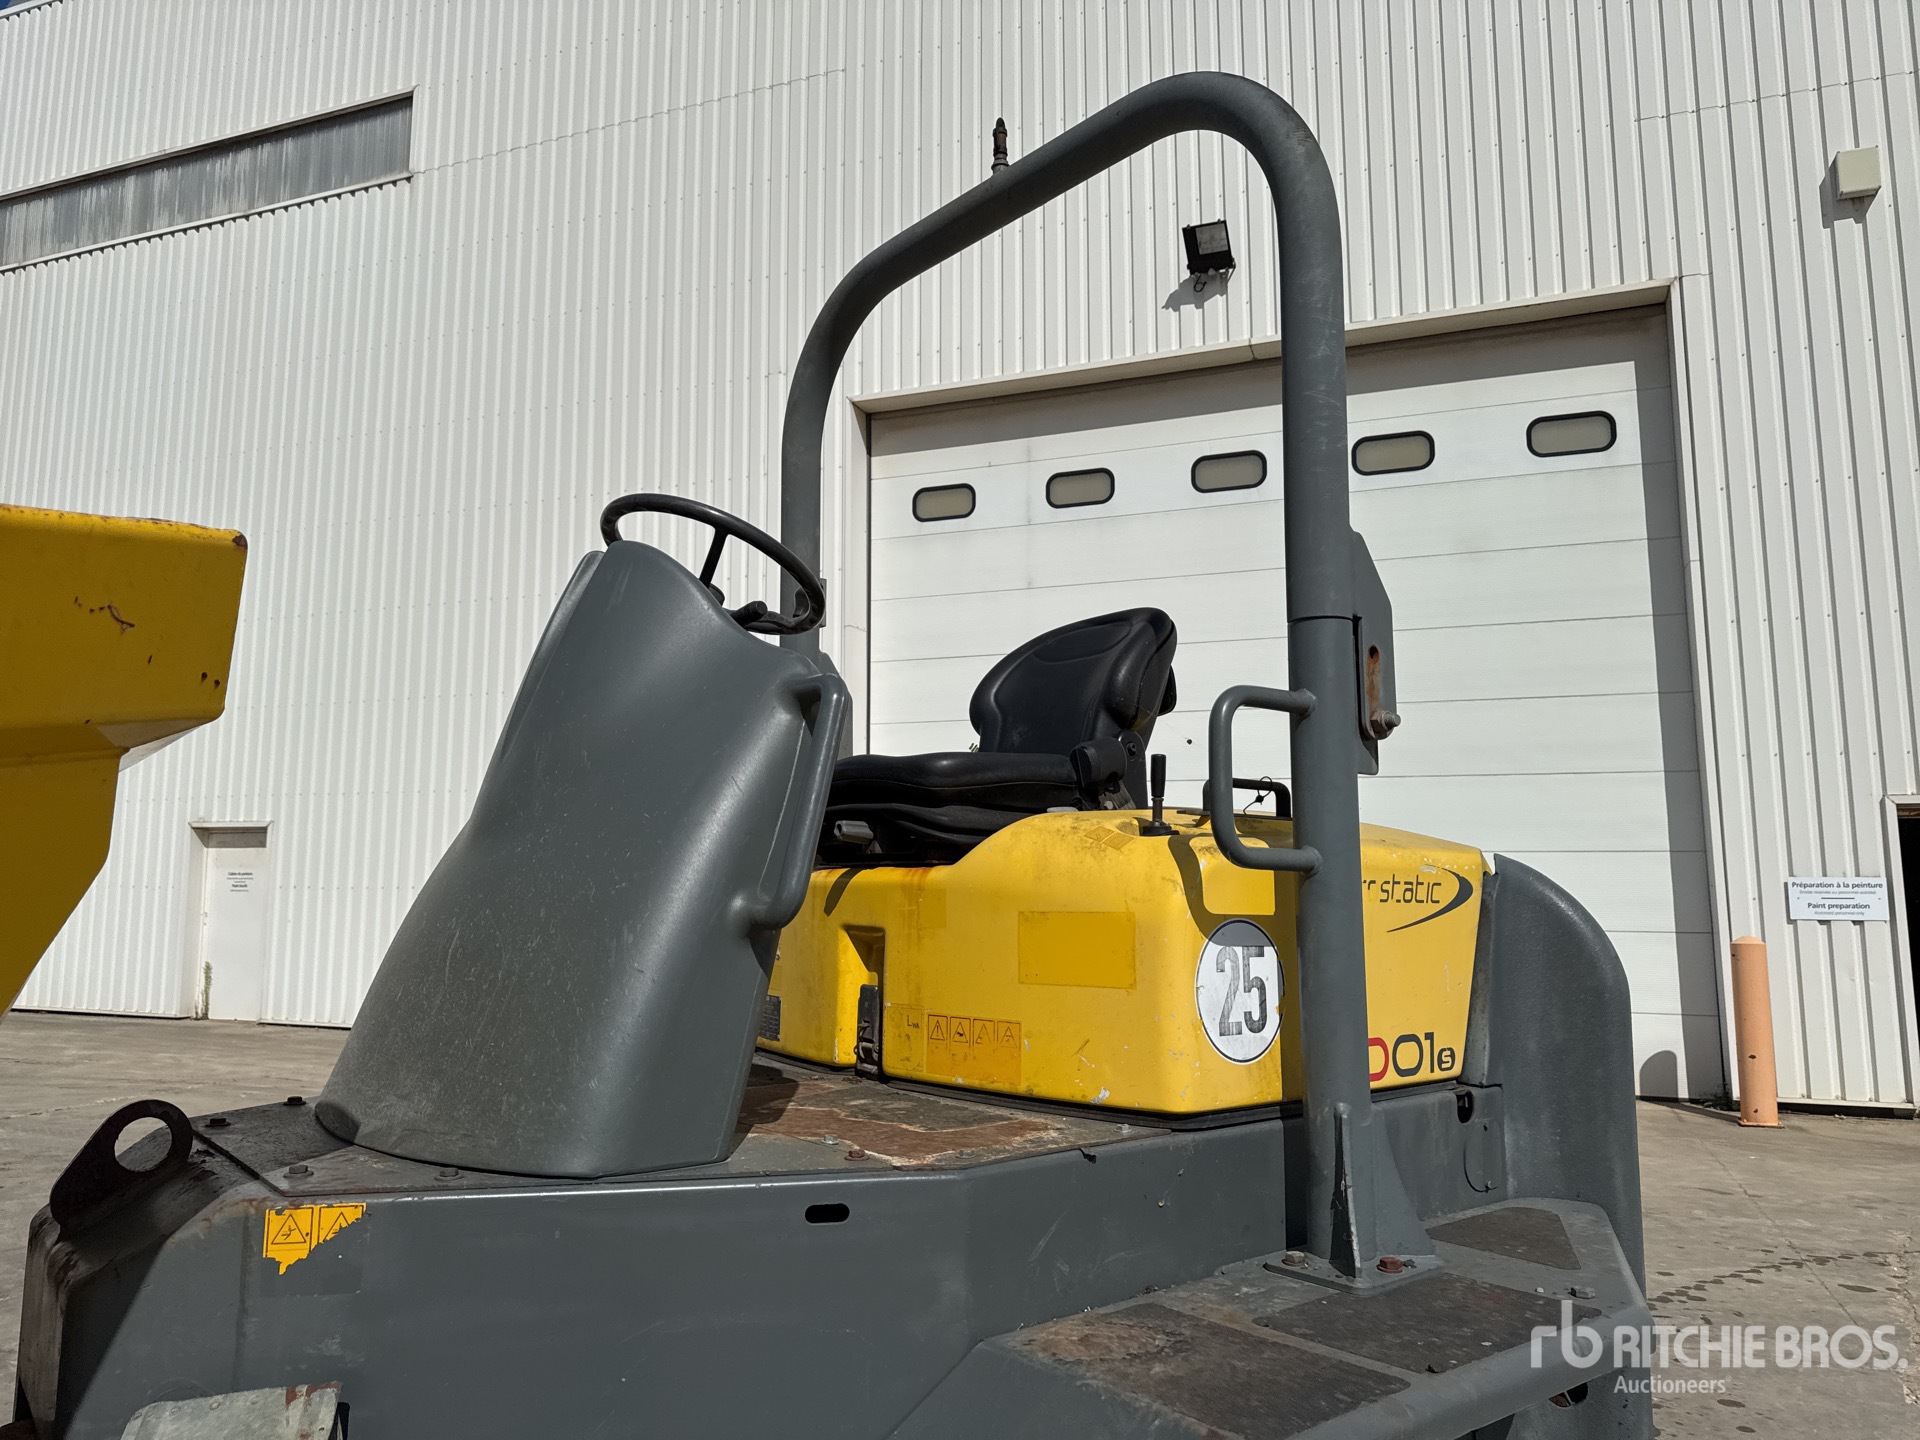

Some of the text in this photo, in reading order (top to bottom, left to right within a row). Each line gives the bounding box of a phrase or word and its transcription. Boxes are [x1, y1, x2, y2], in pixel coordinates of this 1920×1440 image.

[1791, 881, 1834, 889] Préparation
[1828, 902, 1870, 910] preparation
[1216, 945, 1267, 1036] 25
